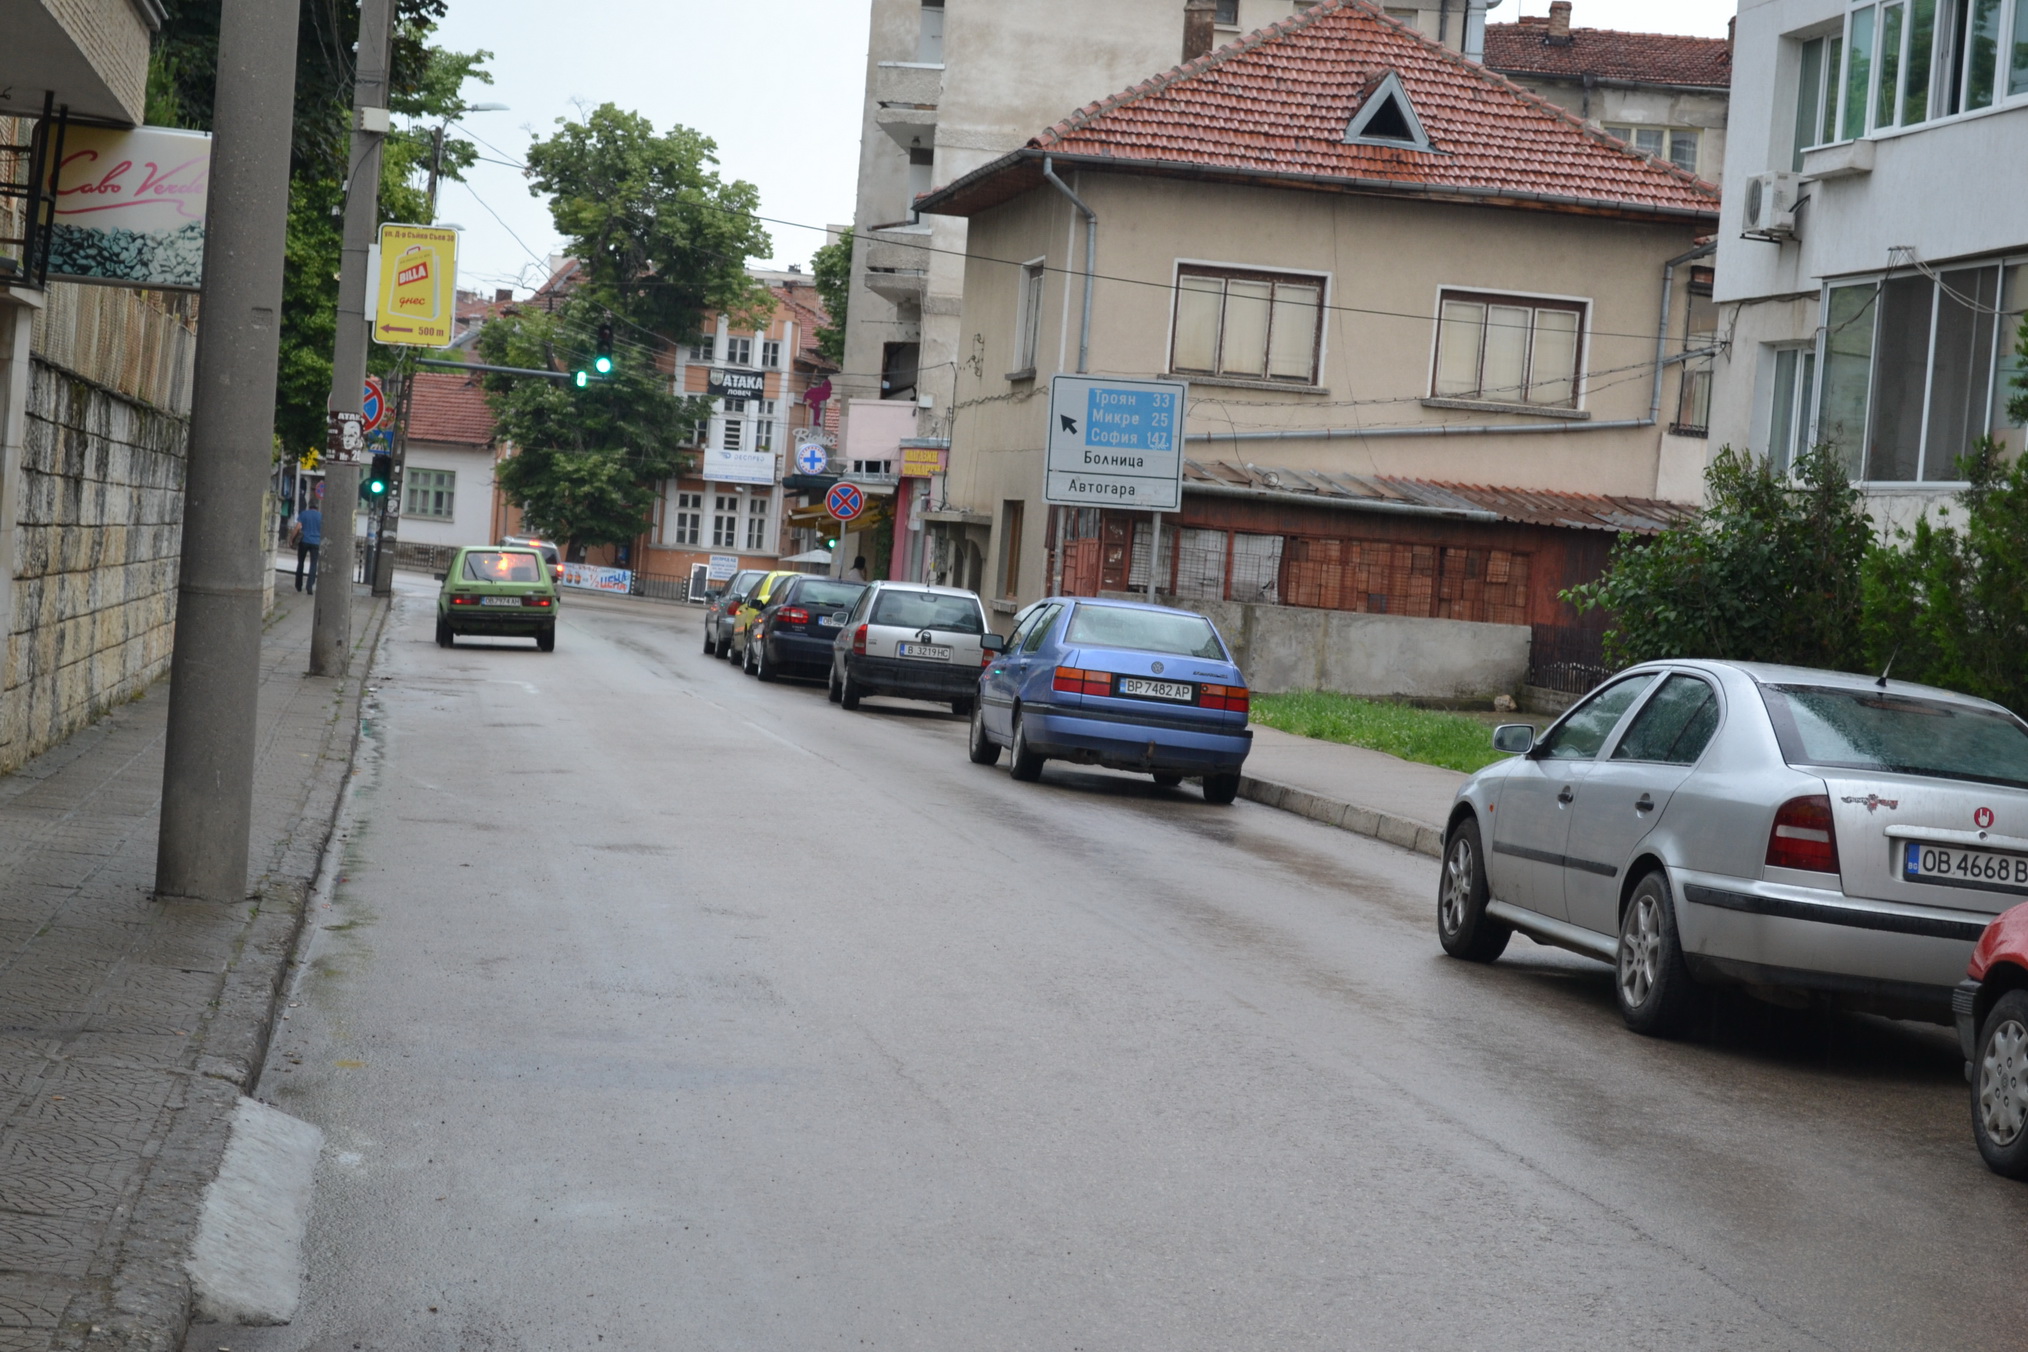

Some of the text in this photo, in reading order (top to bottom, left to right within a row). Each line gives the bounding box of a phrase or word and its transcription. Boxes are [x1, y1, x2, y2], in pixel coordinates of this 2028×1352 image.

[48, 149, 212, 197] Cabo Verde
[400, 265, 427, 284] BILLA
[418, 327, 435, 336] 500
[722, 374, 763, 389] АТАКА
[727, 389, 751, 397] ЛОВЕЧ
[1094, 389, 1170, 407] Троян 33
[1092, 408, 1169, 428] Микре 25
[1091, 428, 1168, 446] София 147
[1084, 450, 1144, 468] Болница
[1068, 478, 1136, 498] Автогара
[1127, 680, 1190, 698] BP 7482 AP
[1908, 862, 1918, 870] BG
[1923, 850, 1951, 874] OB
[1956, 853, 2010, 881] 4668
